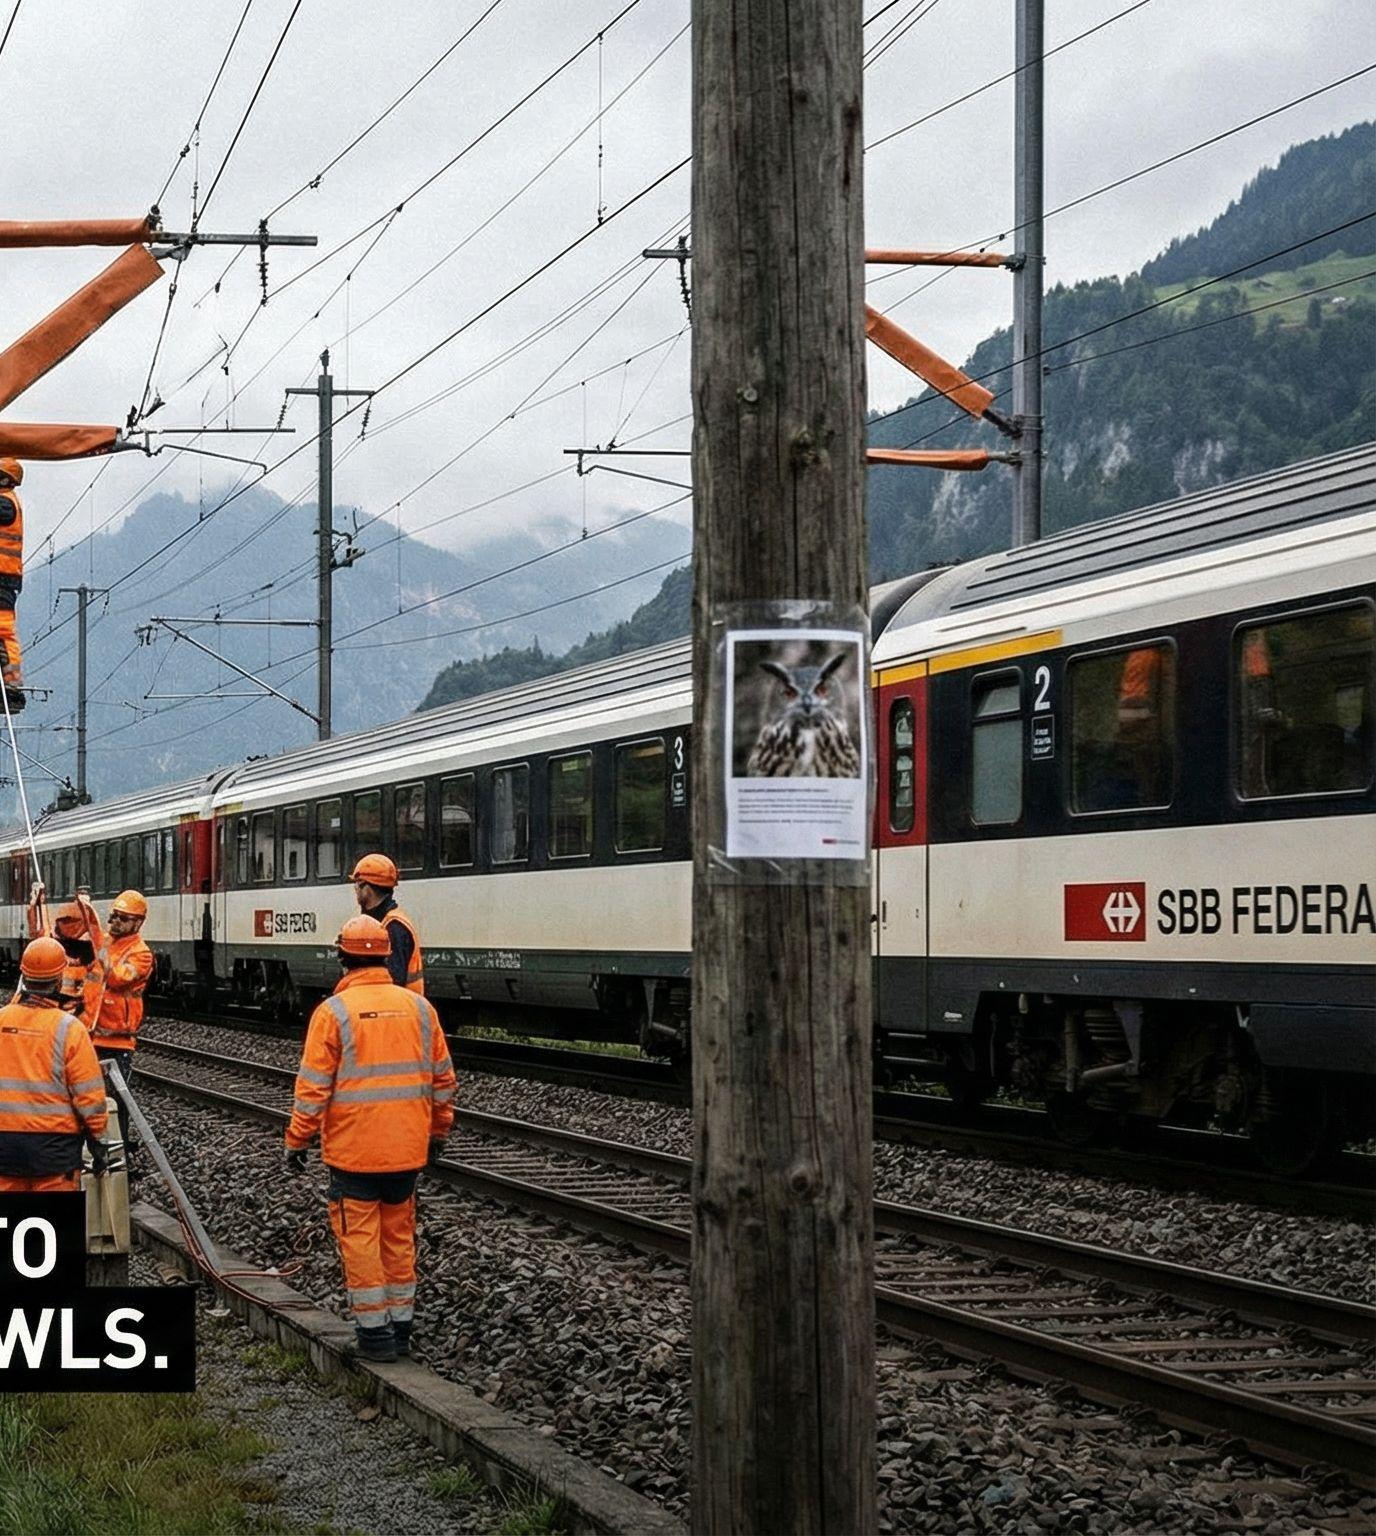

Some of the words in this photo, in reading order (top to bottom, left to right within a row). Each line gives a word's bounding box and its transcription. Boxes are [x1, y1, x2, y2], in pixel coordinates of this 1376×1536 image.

[1034, 665, 1051, 712] 2
[674, 736, 684, 770] 3
[1158, 889, 1221, 934] SBB
[1233, 884, 1376, 934] FEDERA
